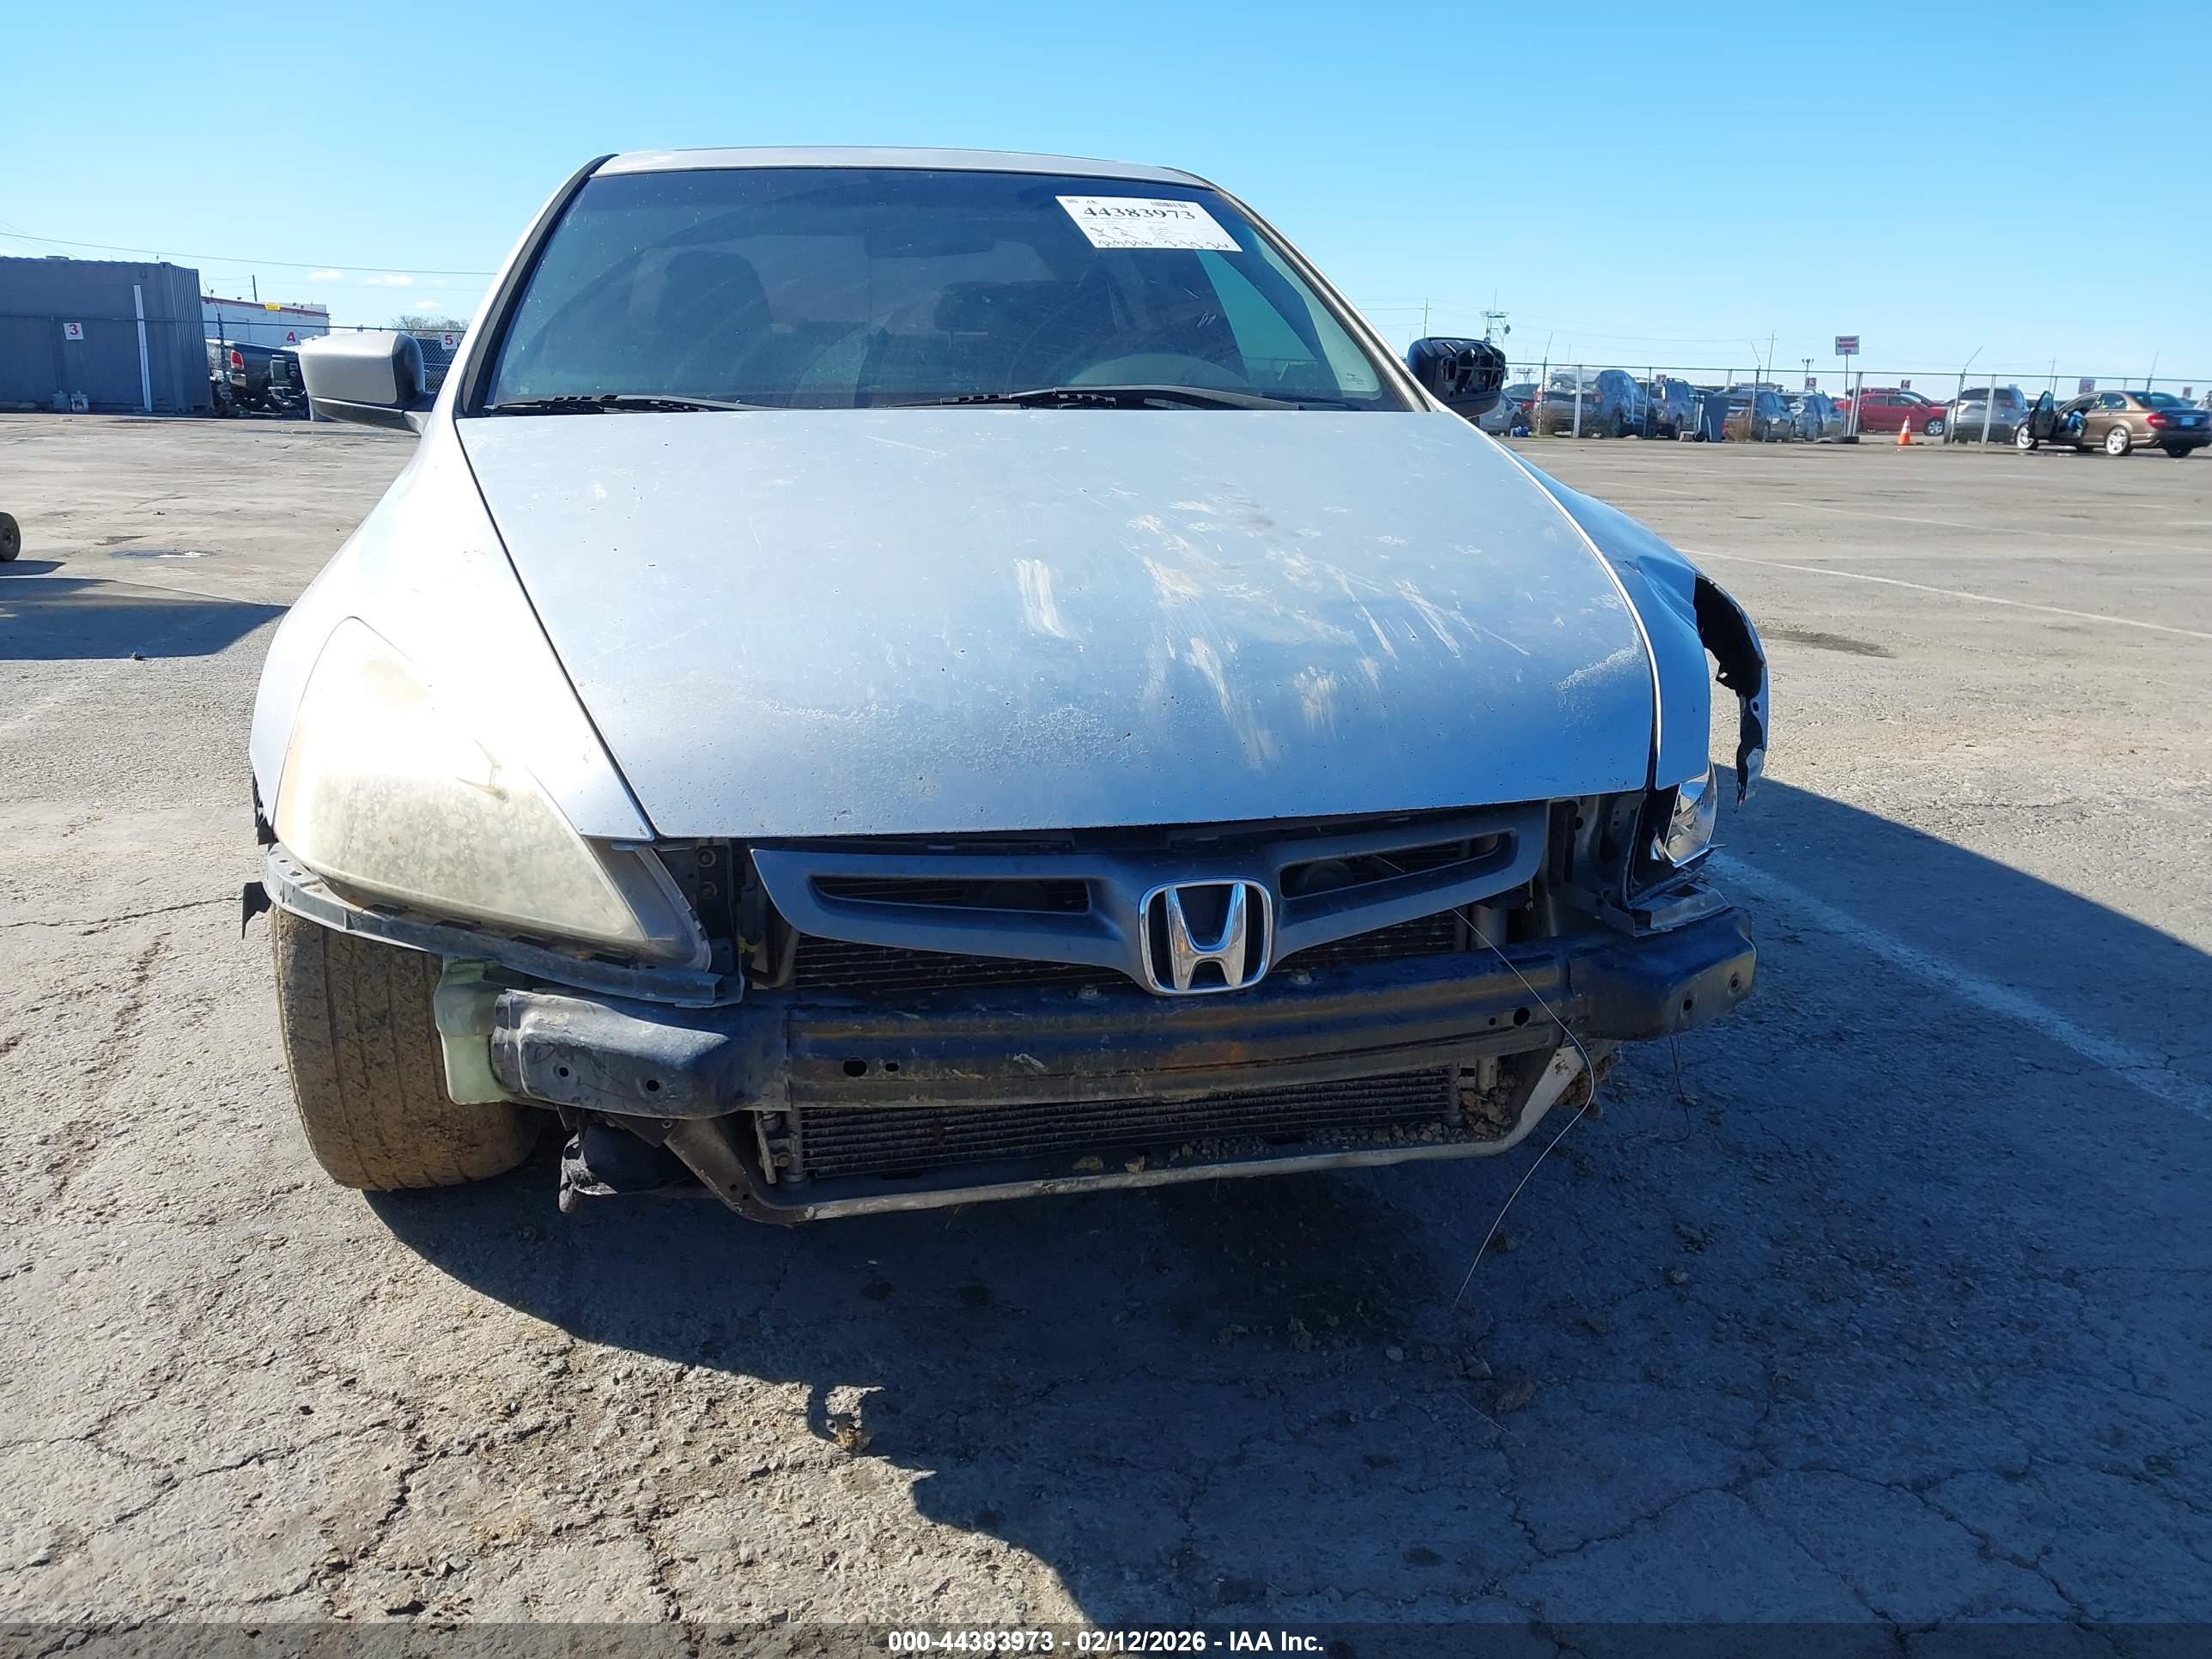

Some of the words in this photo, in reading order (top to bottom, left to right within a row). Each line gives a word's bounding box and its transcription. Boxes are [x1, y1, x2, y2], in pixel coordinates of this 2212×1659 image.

[1084, 207, 1196, 220] 44383973
[69, 324, 79, 336] 3
[286, 331, 296, 343] 4
[444, 334, 453, 346] 5
[1807, 377, 1817, 387] 13
